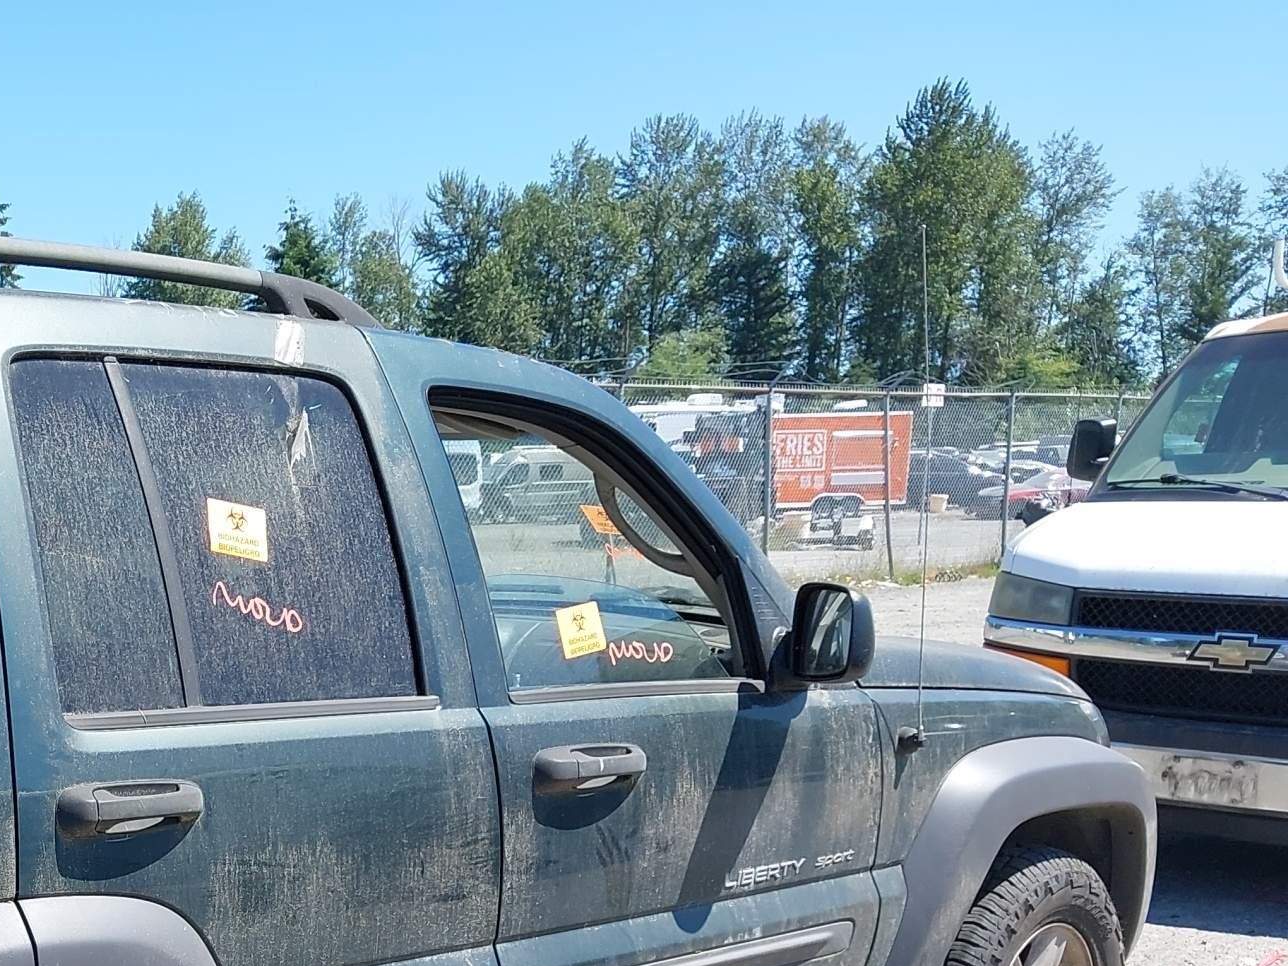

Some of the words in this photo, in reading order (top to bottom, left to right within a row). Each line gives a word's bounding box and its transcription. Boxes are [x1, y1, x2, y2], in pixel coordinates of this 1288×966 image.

[776, 433, 823, 456] FRIES
[775, 456, 794, 468] THE
[724, 858, 807, 888] LIBERTY
